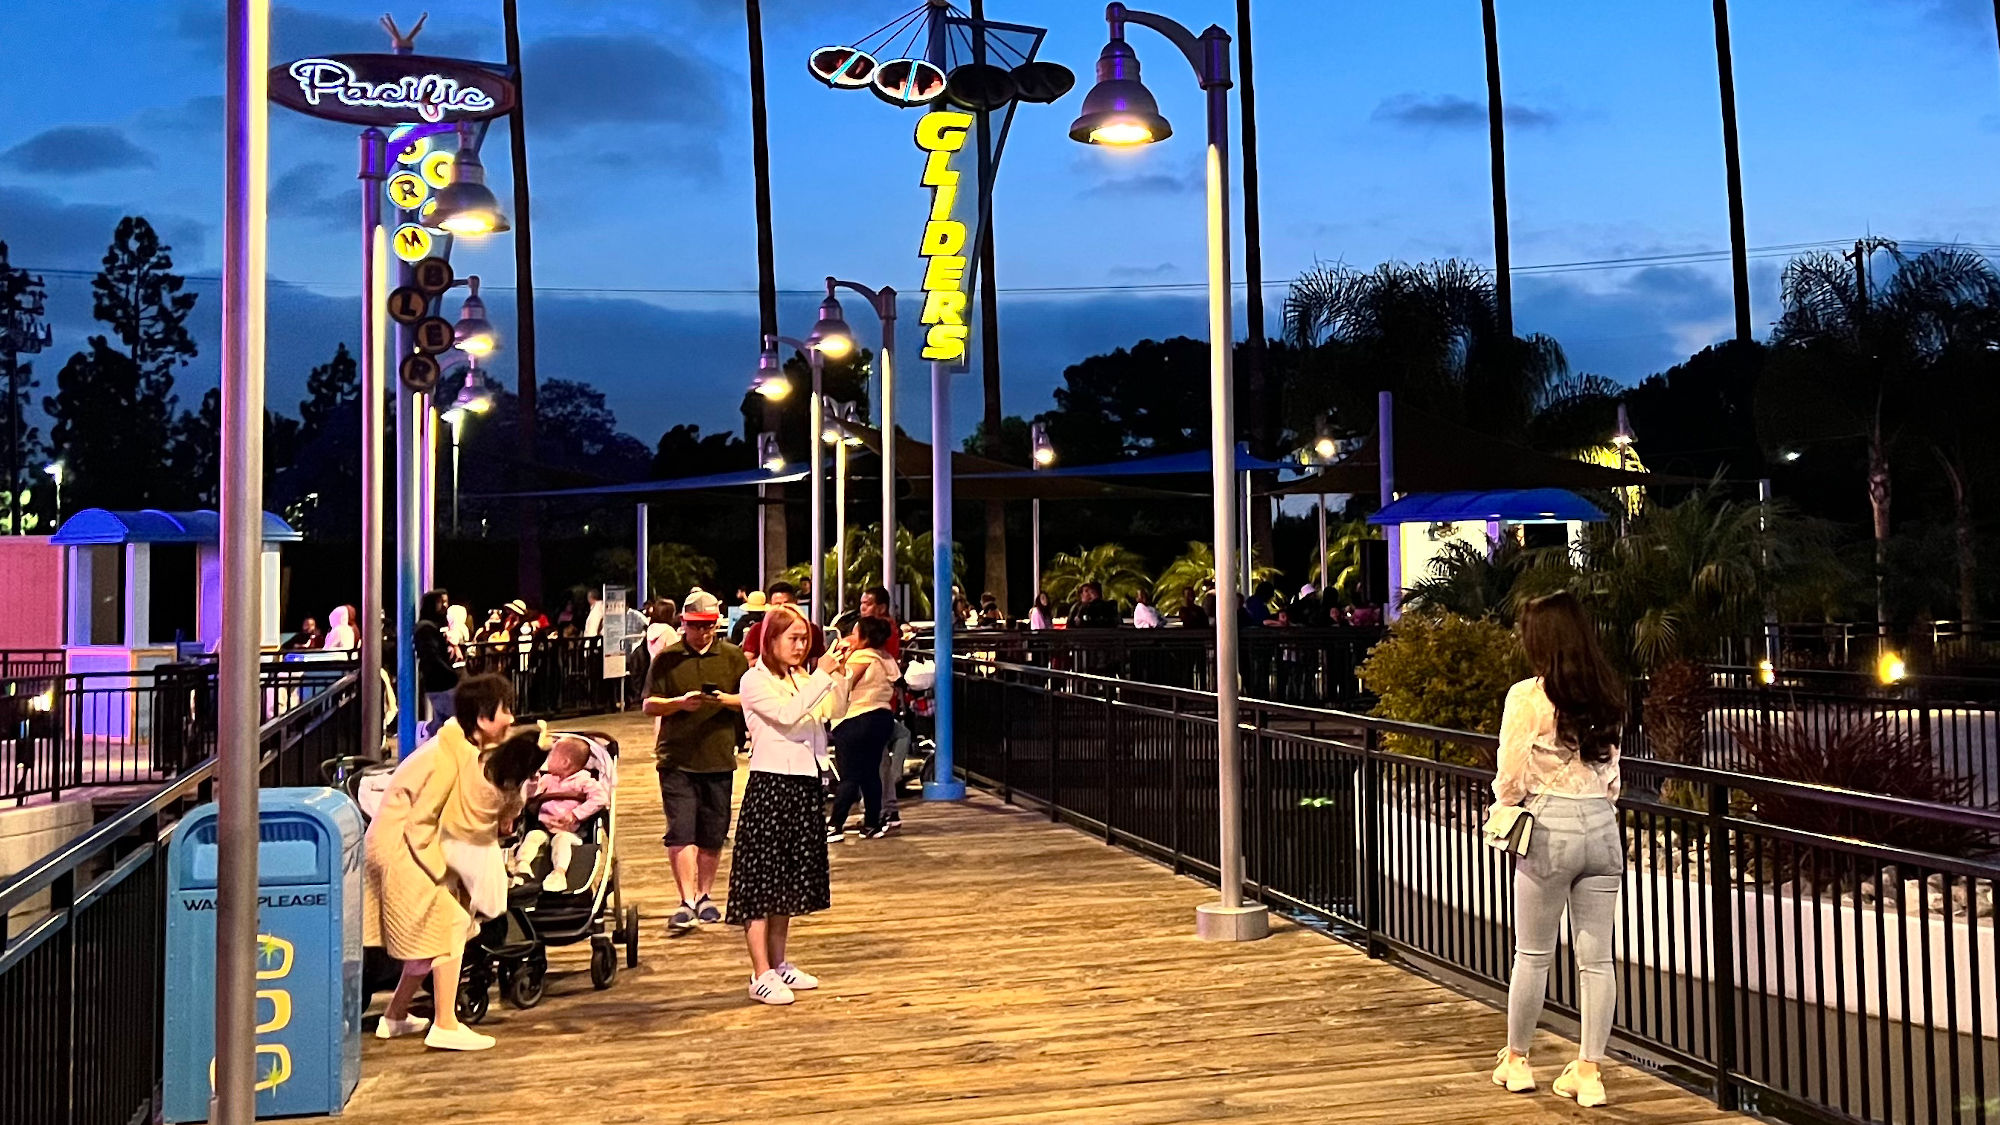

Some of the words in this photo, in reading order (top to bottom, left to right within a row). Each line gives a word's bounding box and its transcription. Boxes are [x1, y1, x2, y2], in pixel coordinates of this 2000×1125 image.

[289, 58, 495, 122] Pacific
[914, 111, 974, 361] GLIDERS
[256, 893, 327, 908] PLEASE
